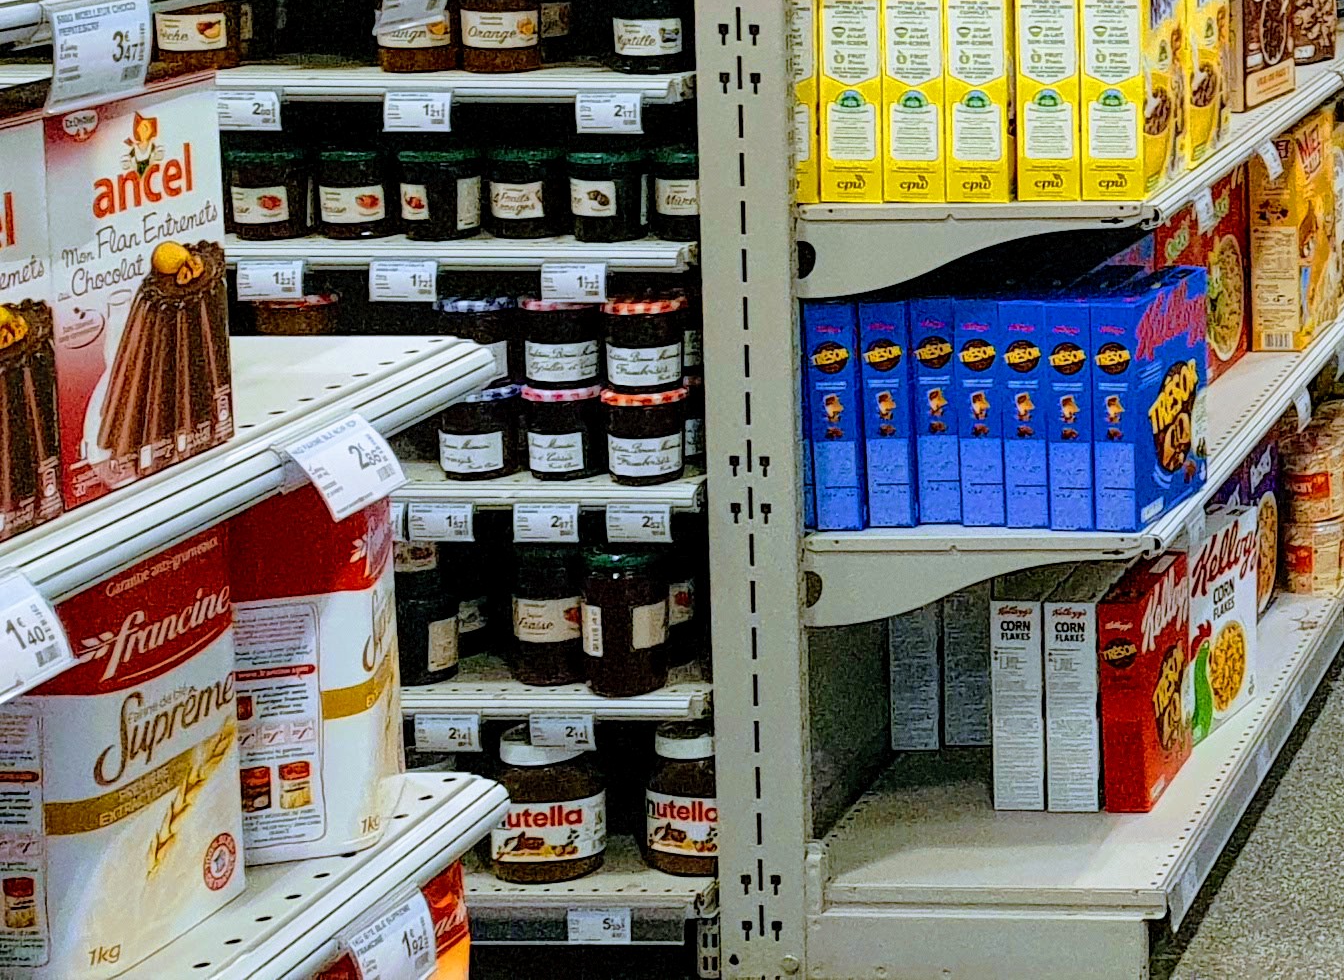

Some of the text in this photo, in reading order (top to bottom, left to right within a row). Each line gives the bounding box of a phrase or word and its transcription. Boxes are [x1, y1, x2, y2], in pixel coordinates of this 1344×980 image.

[92, 142, 194, 220] ancel
[62, 202, 219, 269] Mon Flan Entremets
[71, 258, 145, 297] Chocolat
[1212, 577, 1236, 606] CORN
[1212, 595, 1236, 620] FLAKES
[102, 585, 232, 681] francine
[1000, 620, 1031, 633] CORN
[1000, 632, 1032, 641] FLAKES
[1055, 621, 1086, 634] CORN
[1055, 633, 1086, 643] FLAKES
[94, 670, 236, 786] Suprême
[360, 815, 381, 836] 1kg
[87, 944, 122, 967] 1kg
